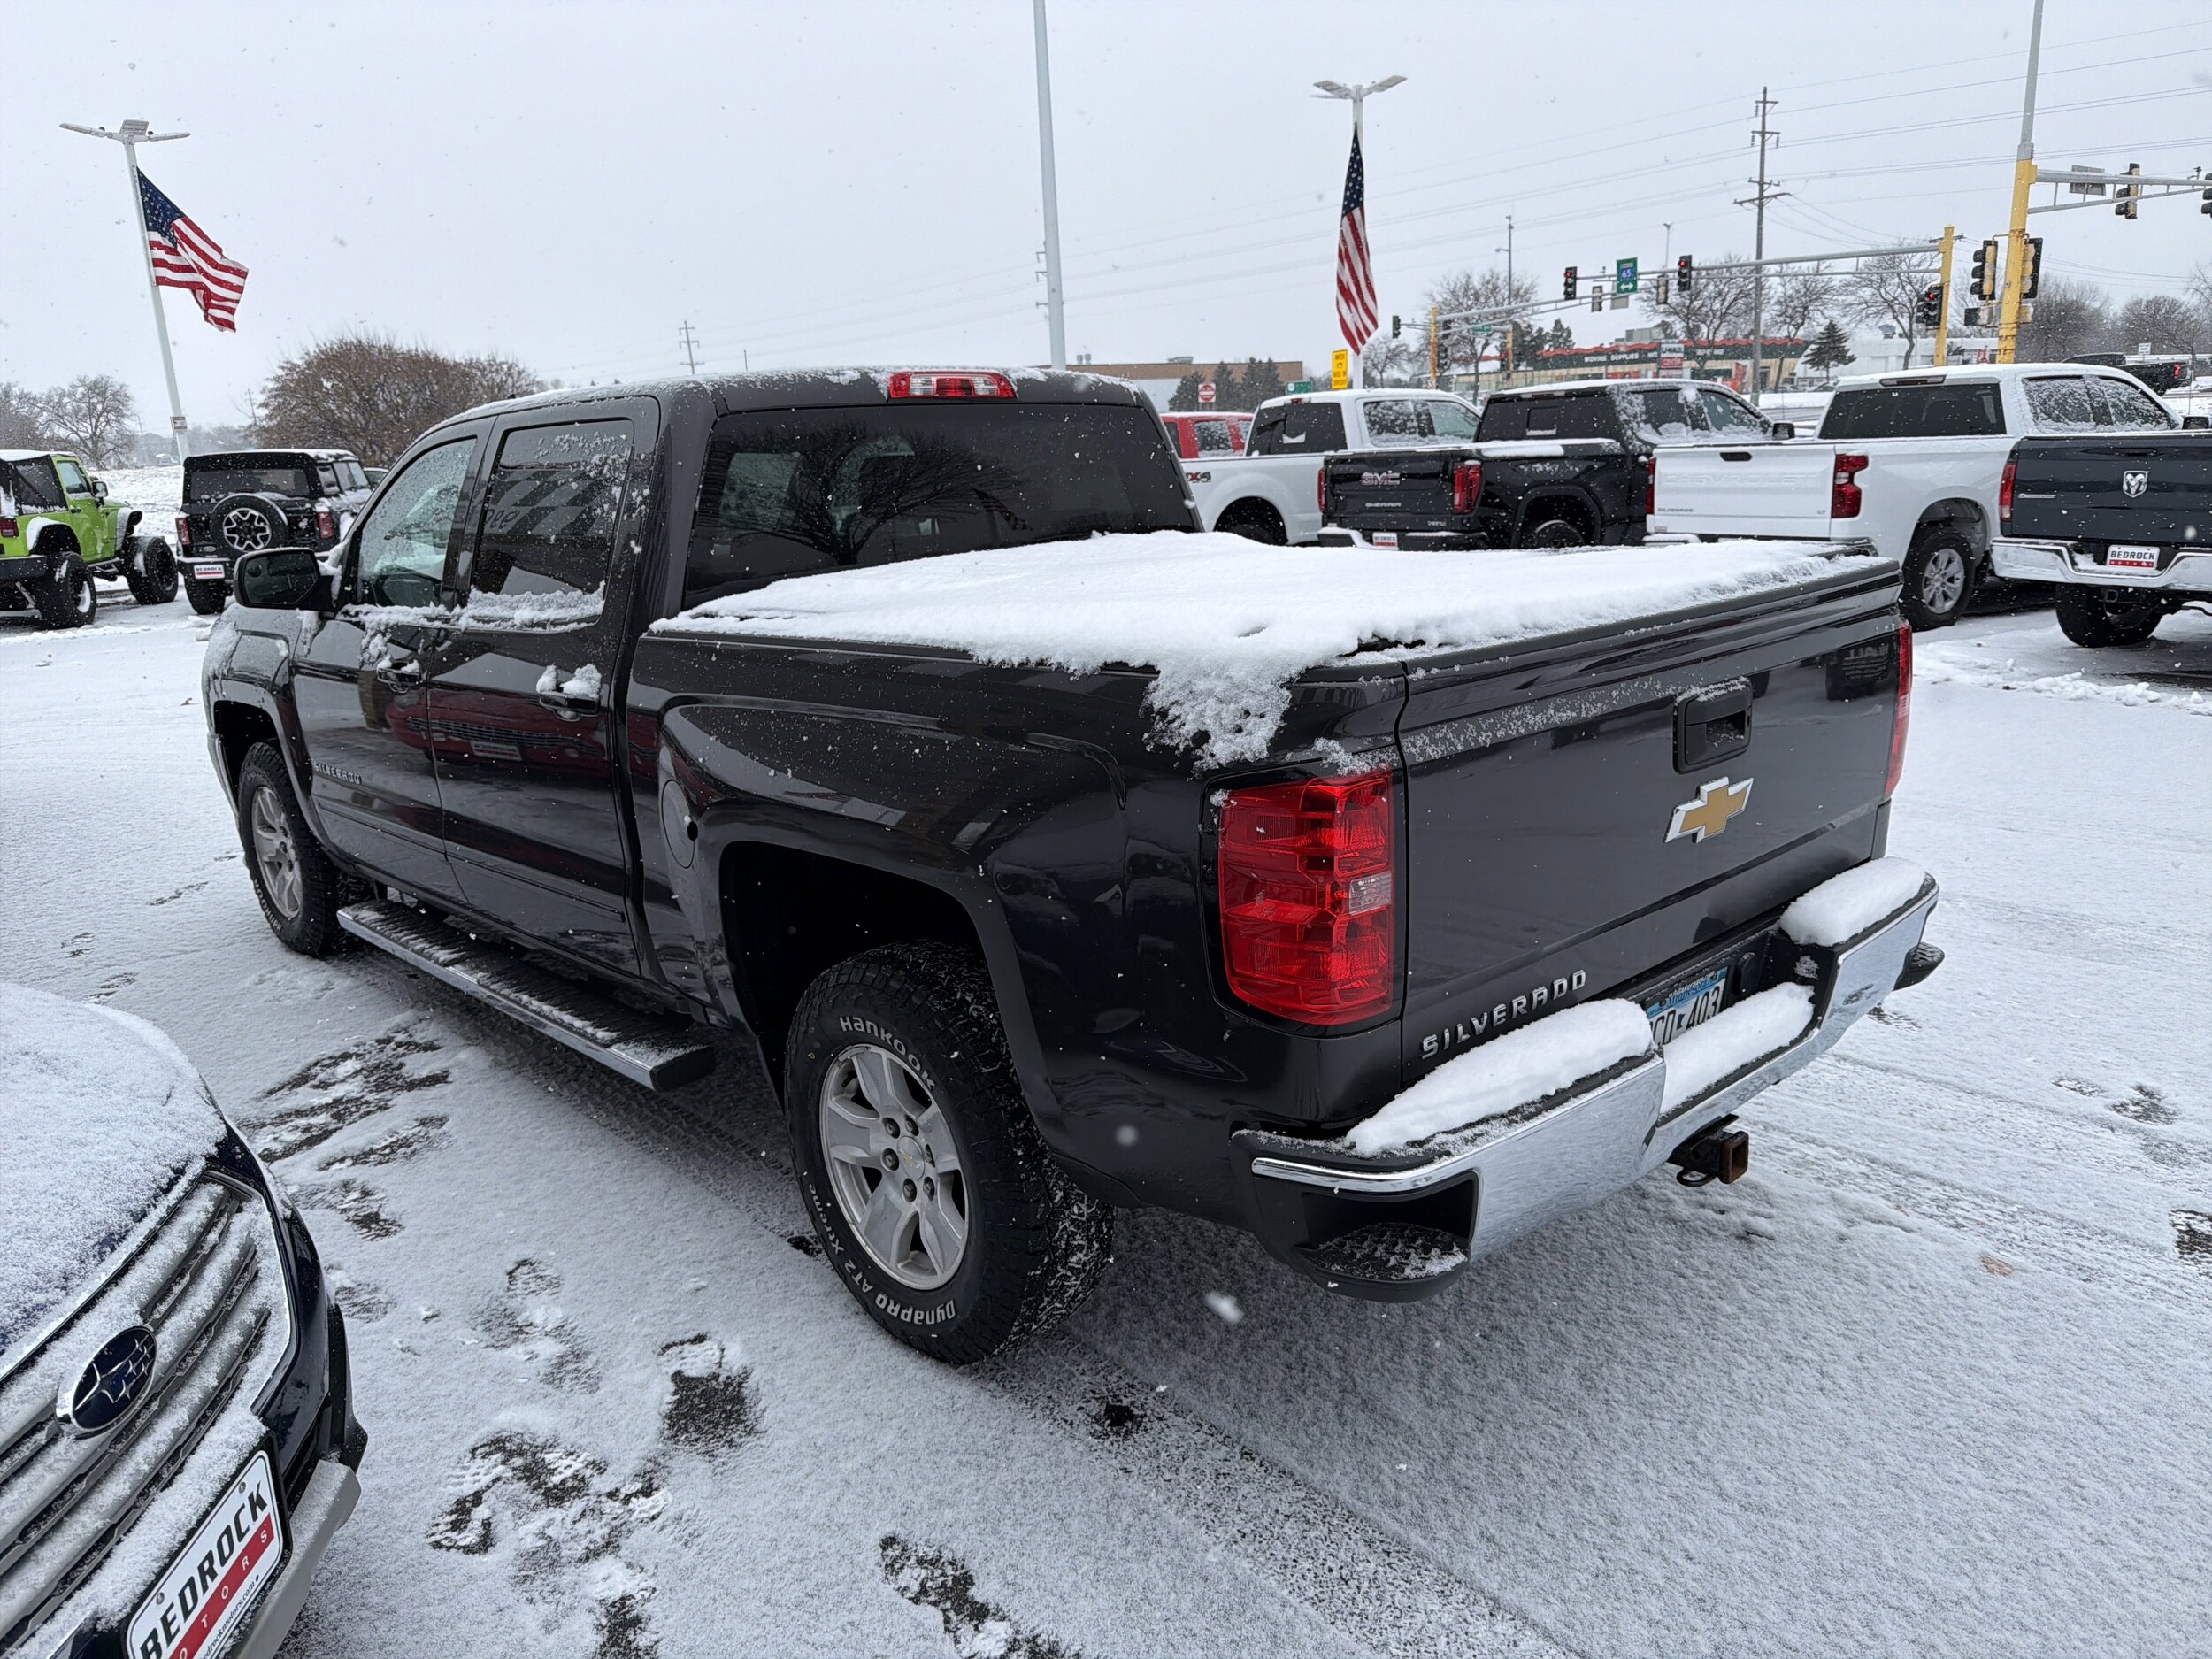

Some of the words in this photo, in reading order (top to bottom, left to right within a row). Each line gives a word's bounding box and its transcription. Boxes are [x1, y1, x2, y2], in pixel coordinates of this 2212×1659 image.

[1361, 472, 1401, 486] GMC
[2110, 550, 2155, 560] BEDROCK
[313, 762, 363, 785] SILVERADO
[1420, 969, 1587, 1060] SILVERADO
[1649, 1009, 1677, 1045] CD
[1686, 985, 1721, 1030] 403
[809, 1183, 845, 1256] Xtreme
[844, 1259, 874, 1294] AT2
[139, 1480, 268, 1659] BEDROCK
[179, 1530, 268, 1659] OTORS
